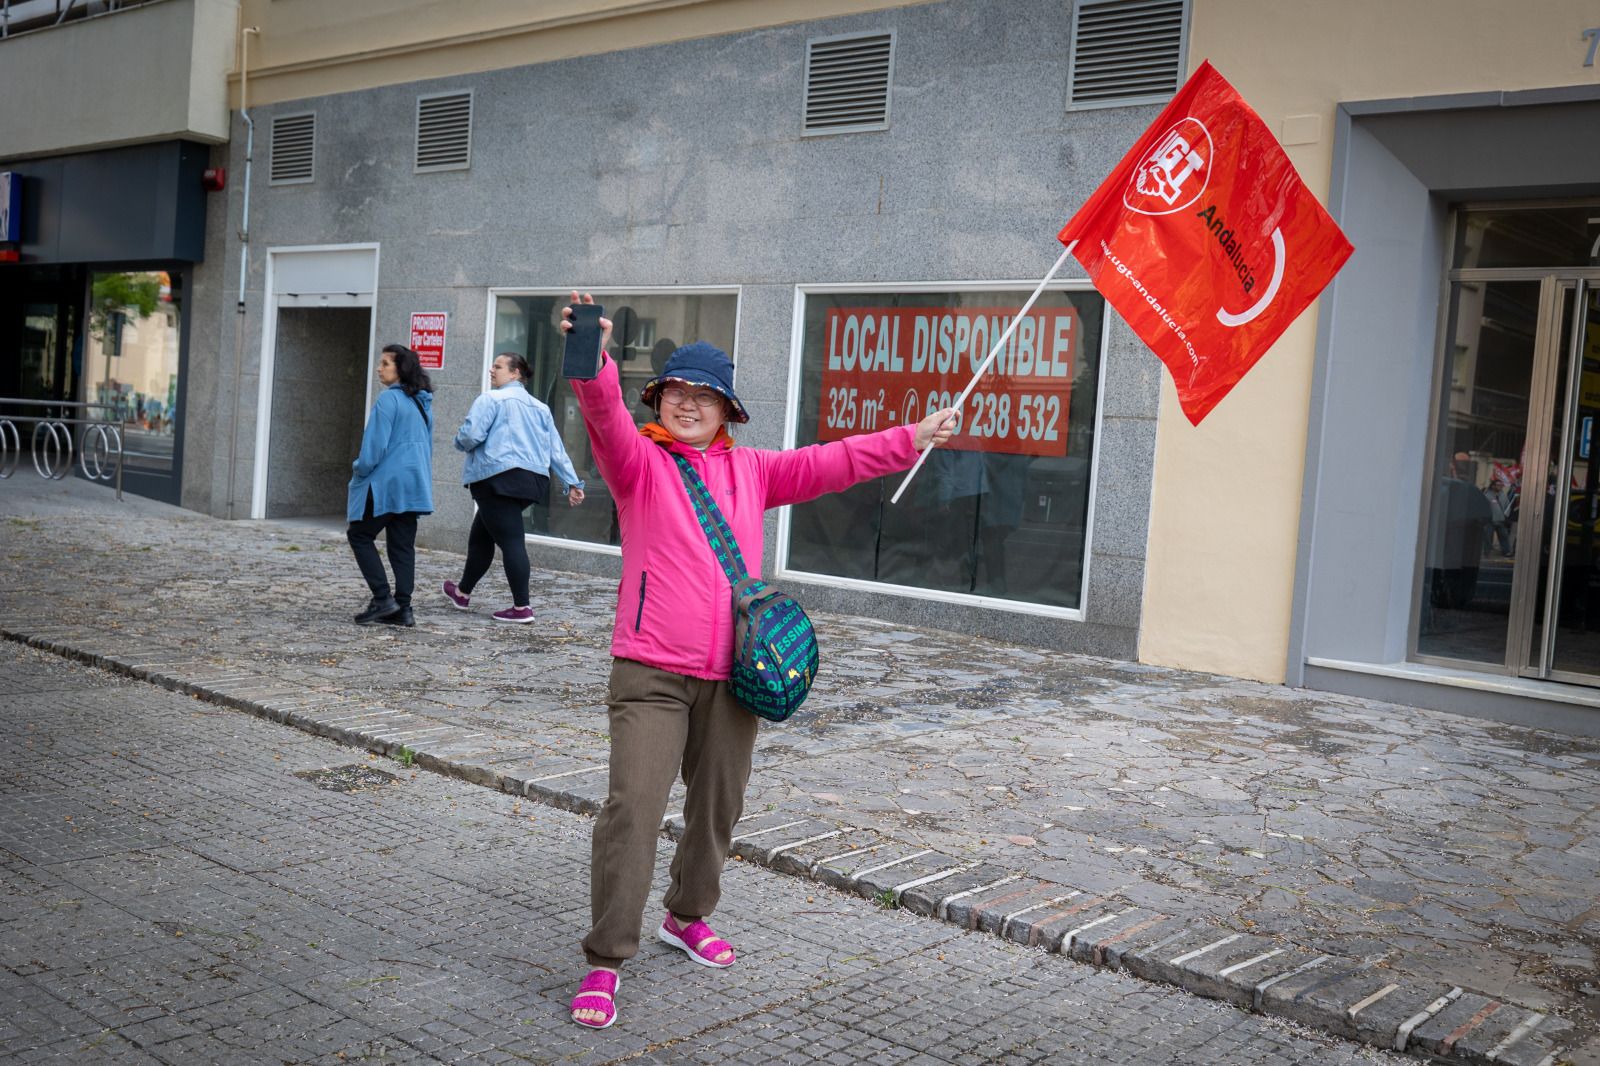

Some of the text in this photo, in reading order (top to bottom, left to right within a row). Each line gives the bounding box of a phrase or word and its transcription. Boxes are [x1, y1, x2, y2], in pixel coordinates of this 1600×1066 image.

[1146, 130, 1204, 202] UGT
[1196, 204, 1256, 294] Andalucía
[412, 316, 444, 331] PROHIBIDO
[423, 331, 443, 346] Carteles
[828, 314, 1072, 377] LOCAL DISPONIBLE
[827, 386, 858, 430] 325
[969, 392, 1010, 438] 238
[1016, 394, 1061, 441] 532
